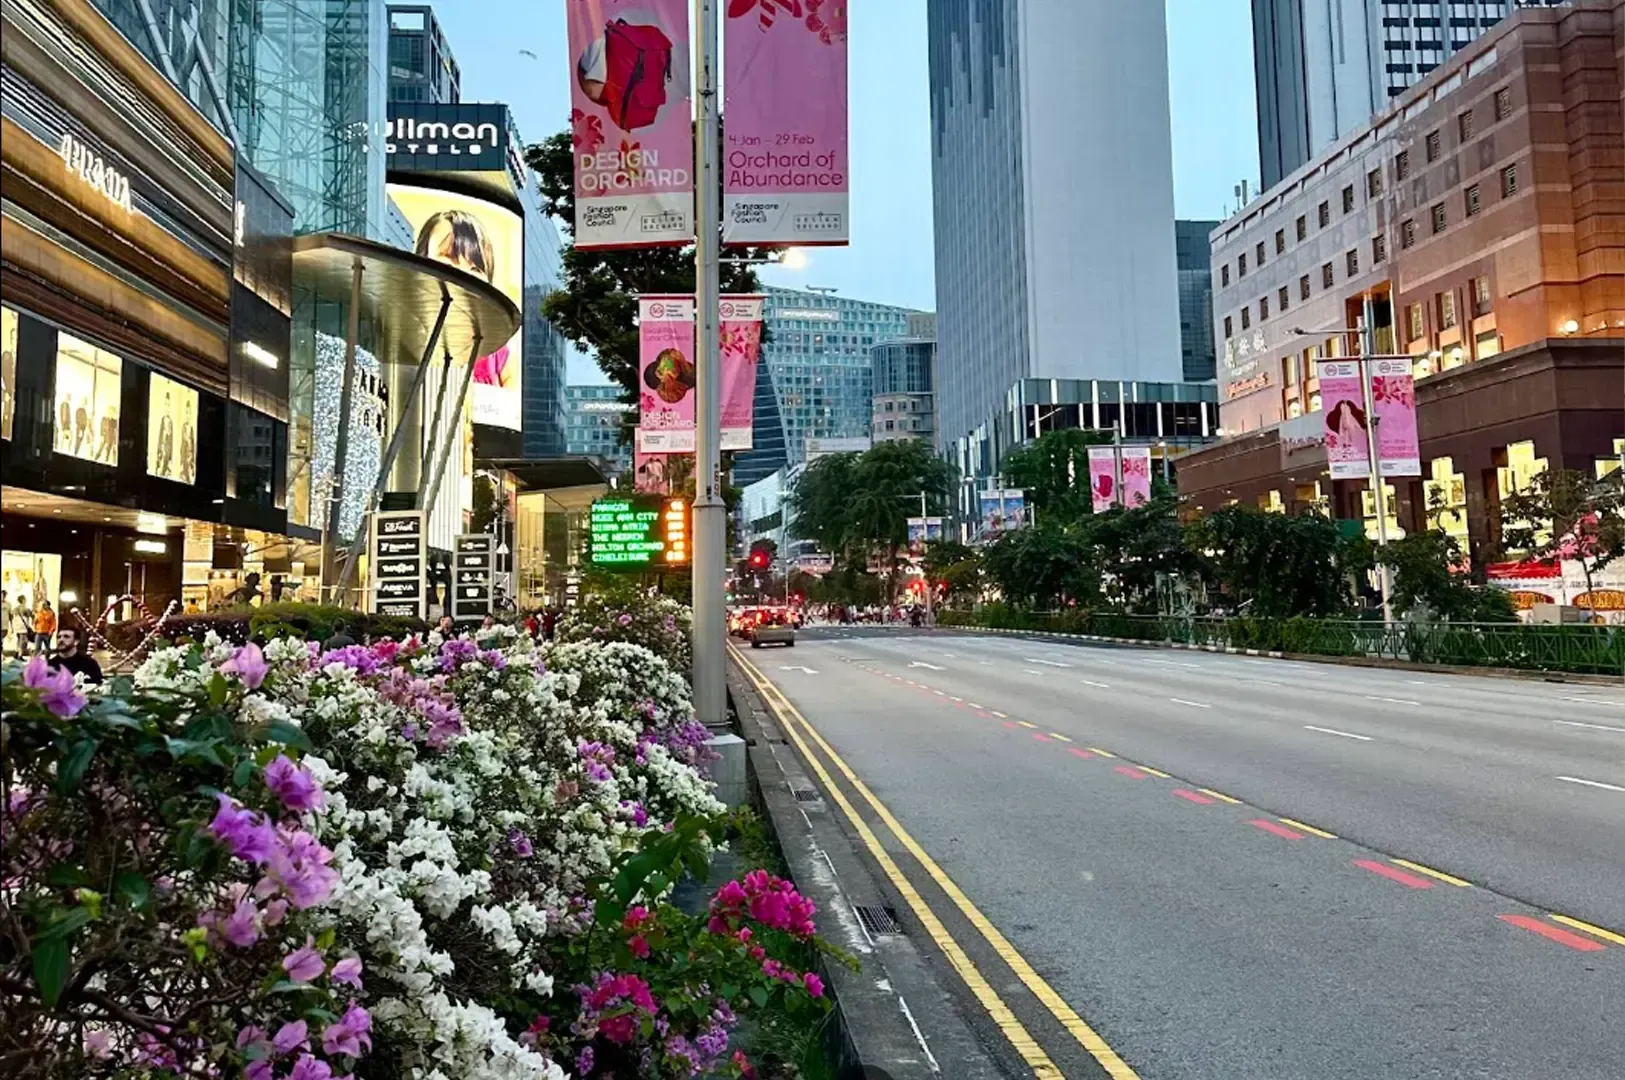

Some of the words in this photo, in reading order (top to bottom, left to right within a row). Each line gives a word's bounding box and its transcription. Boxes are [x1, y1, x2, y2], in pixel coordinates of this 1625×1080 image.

[729, 135, 737, 146] 4
[740, 136, 761, 146] Jan
[775, 133, 790, 145] 29
[793, 133, 815, 145] Feb
[580, 150, 659, 171] DESIGN
[729, 150, 810, 169] Orchard
[815, 150, 836, 170] of
[580, 169, 689, 191] ORCHARD
[729, 169, 844, 187] Abundance
[586, 204, 628, 215] Singapore
[735, 203, 779, 213] Singapore
[583, 212, 615, 222] Fashion
[731, 209, 765, 218] Fashion
[586, 218, 616, 227] Council
[734, 215, 767, 224] Council
[636, 512, 659, 521] CITY
